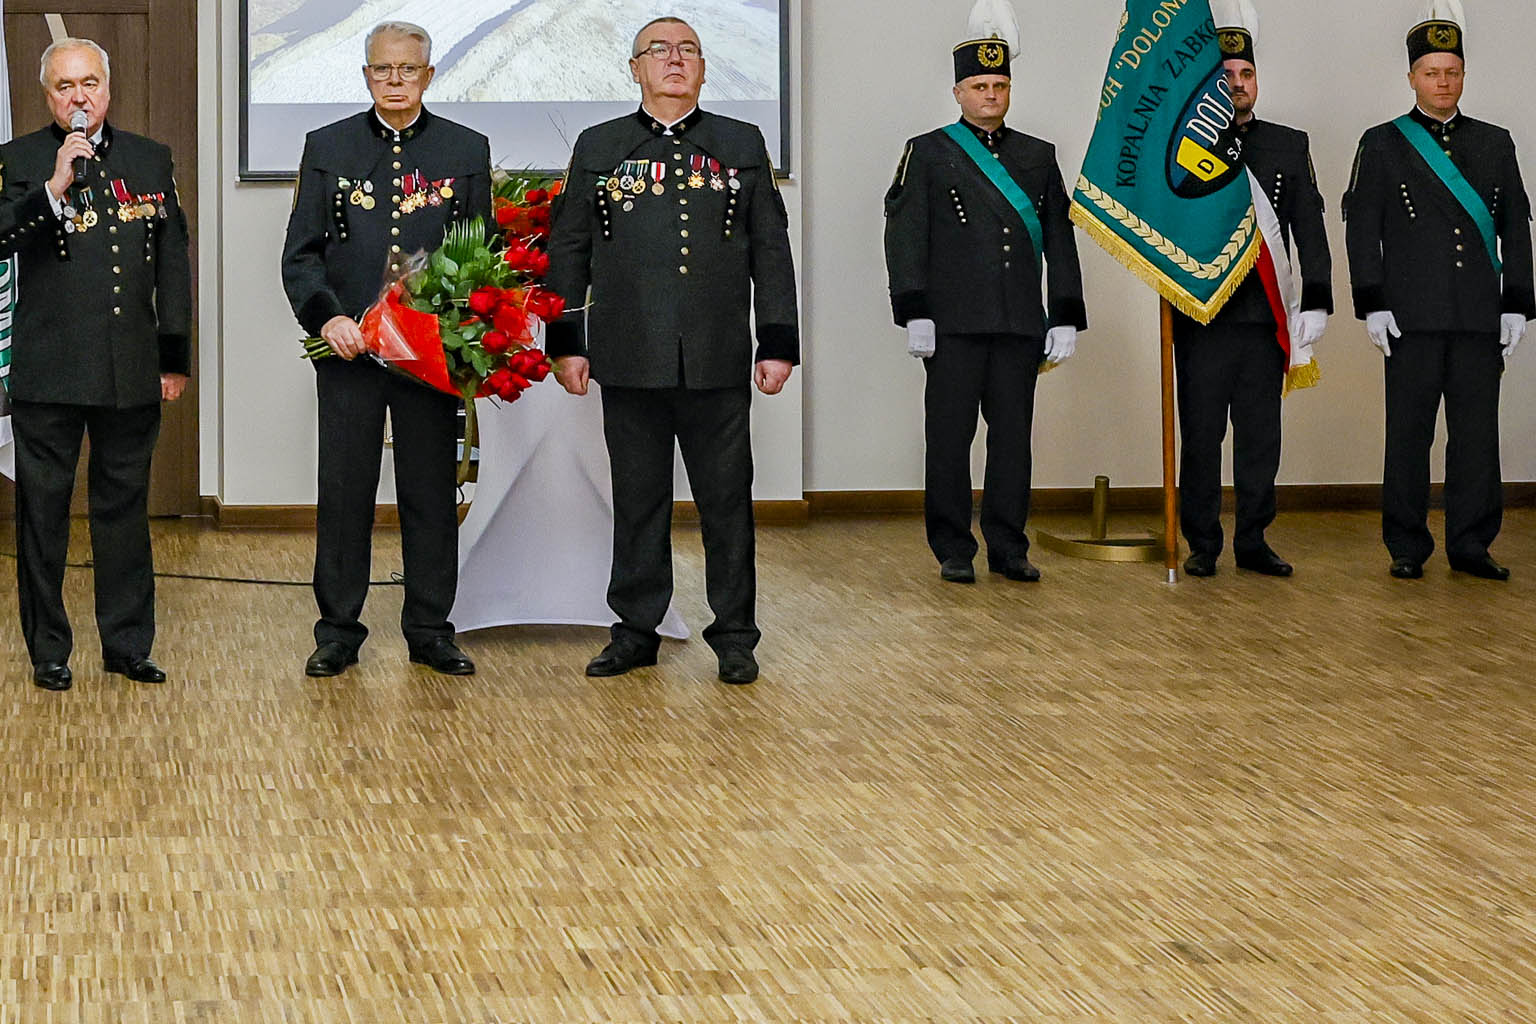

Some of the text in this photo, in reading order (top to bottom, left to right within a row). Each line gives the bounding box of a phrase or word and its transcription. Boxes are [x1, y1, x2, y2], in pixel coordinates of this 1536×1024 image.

[1097, 76, 1124, 122] UH
[1116, 84, 1169, 188] KOPALNIA
[1197, 158, 1215, 175] D
